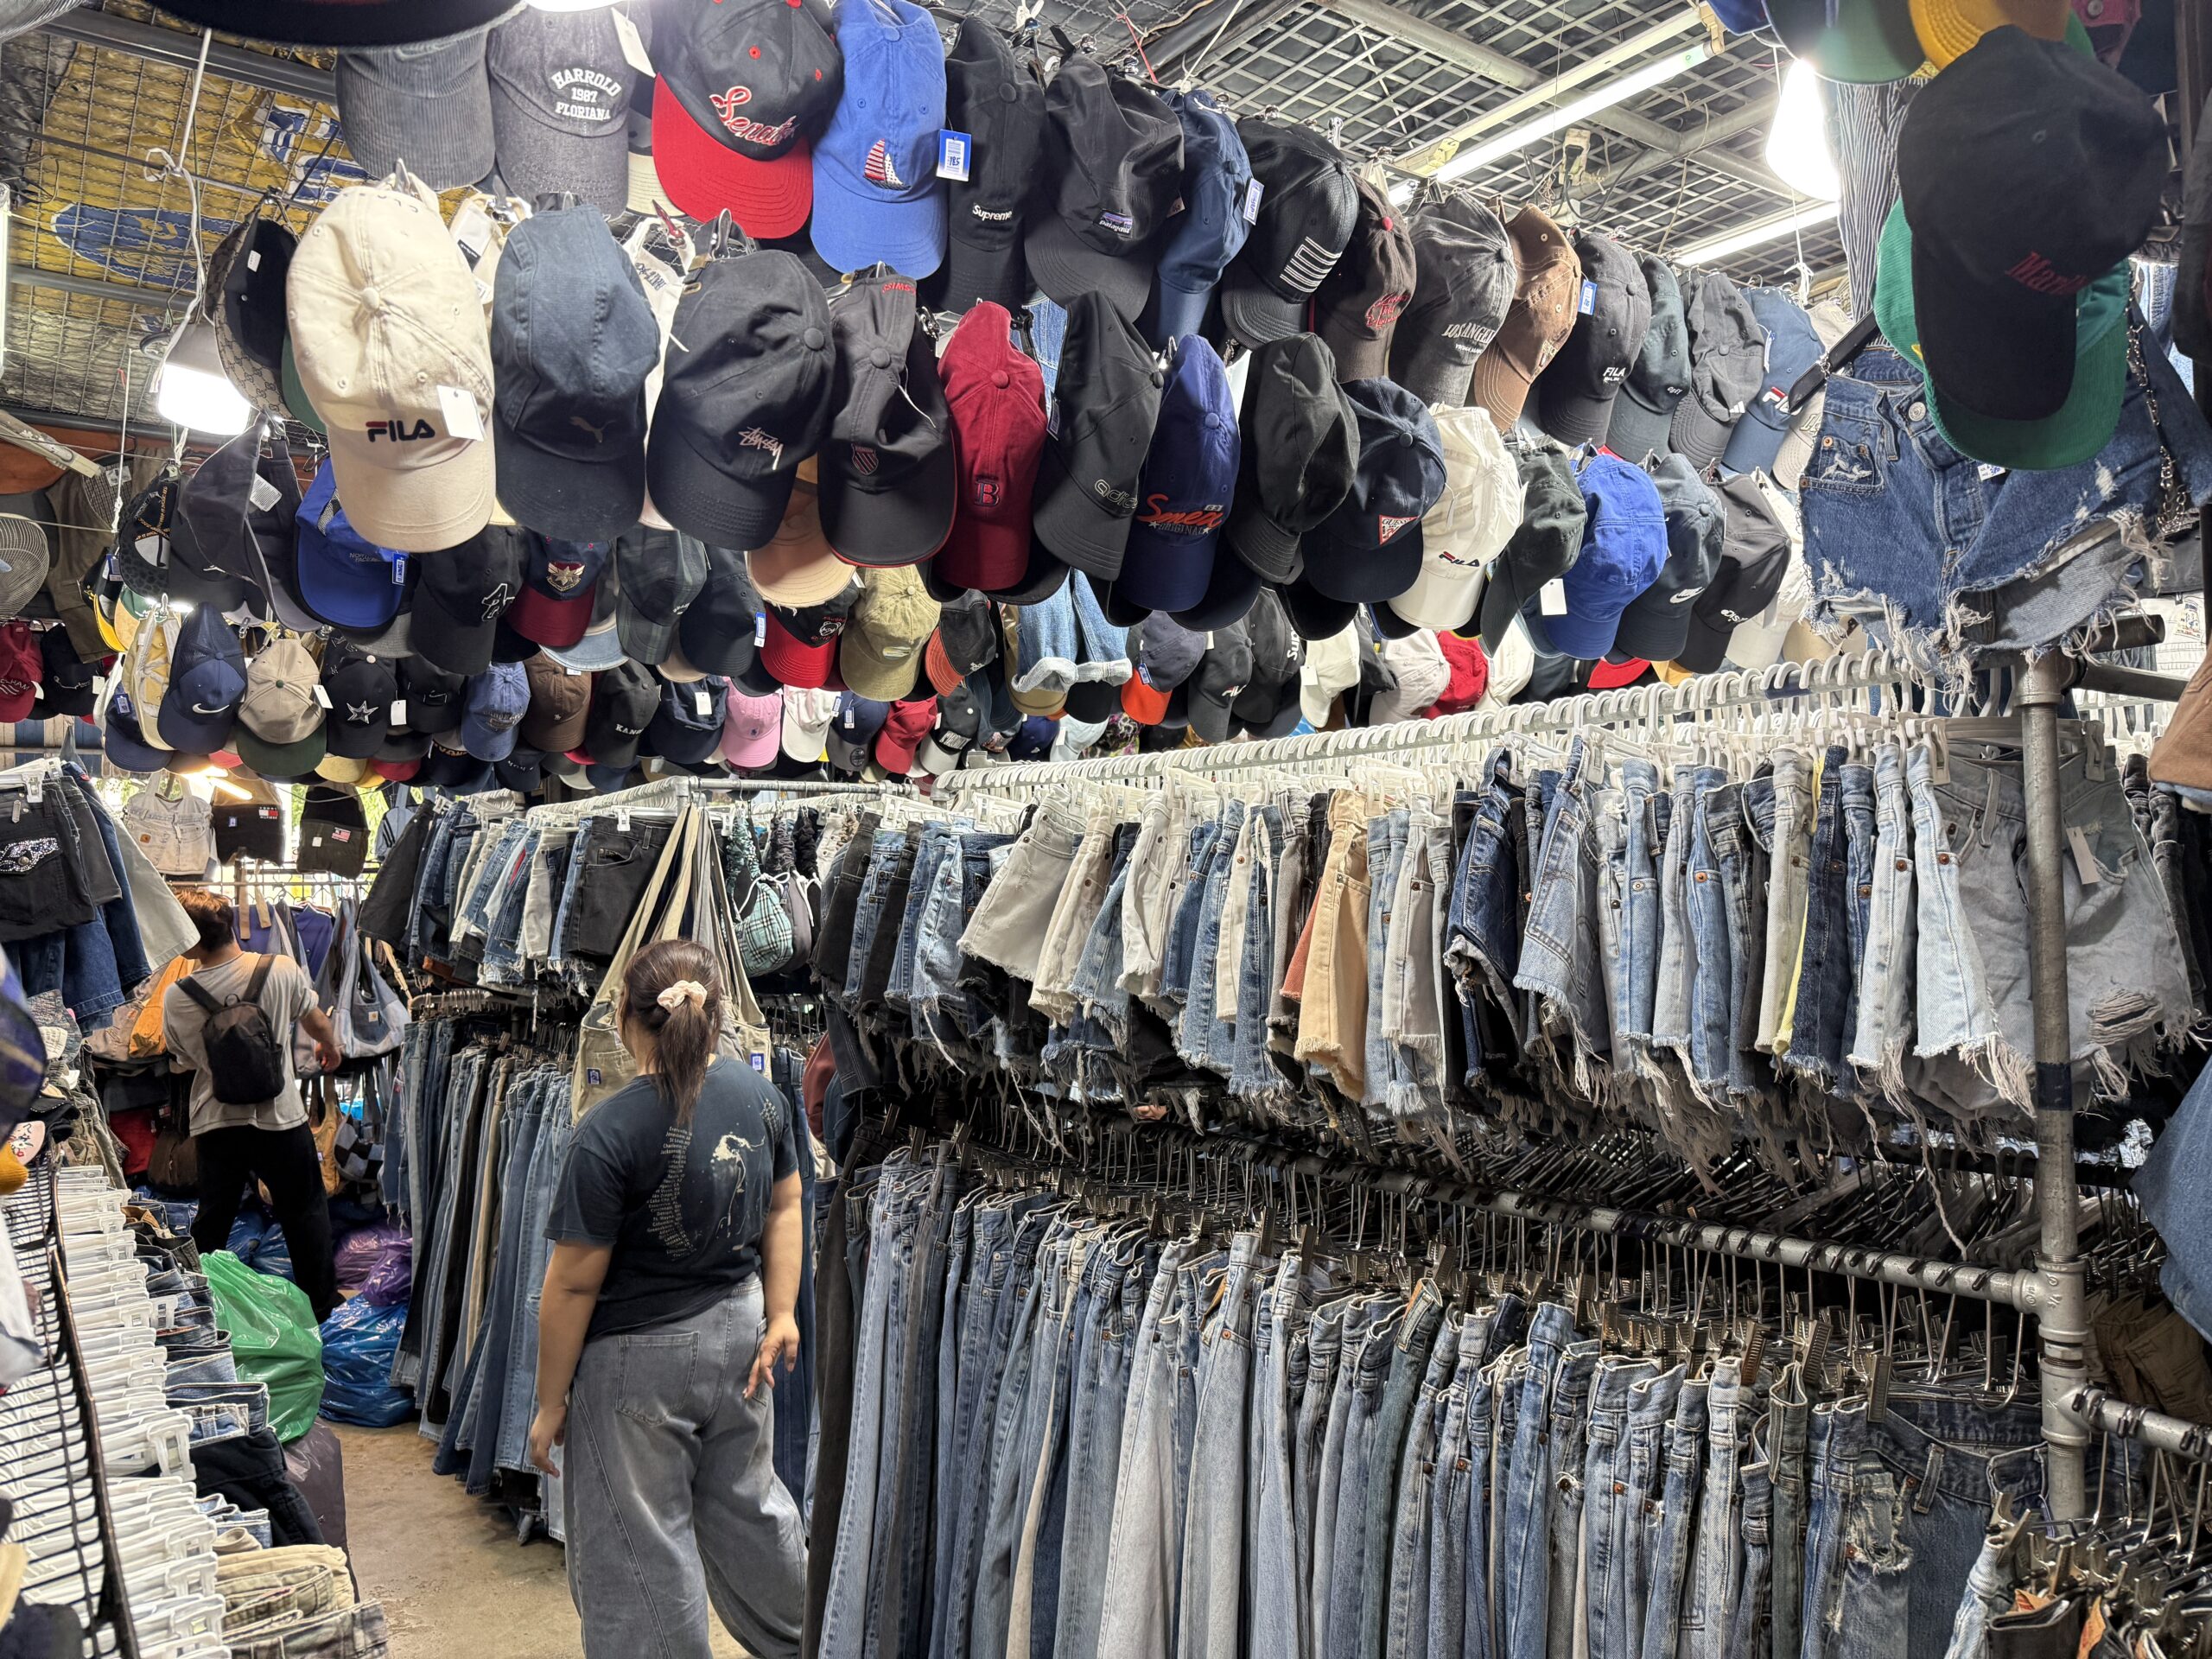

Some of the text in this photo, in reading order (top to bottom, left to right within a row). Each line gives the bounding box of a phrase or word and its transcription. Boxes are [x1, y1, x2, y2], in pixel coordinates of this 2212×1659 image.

[551, 68, 622, 97] HARROLD
[571, 87, 598, 103] 1987
[555, 102, 611, 121] FLORIANA
[1460, 322, 1496, 344] ANGEL
[1603, 366, 1626, 377] FILA
[365, 418, 435, 442] FILA
[974, 481, 1001, 507] B
[1439, 550, 1480, 568] FILA
